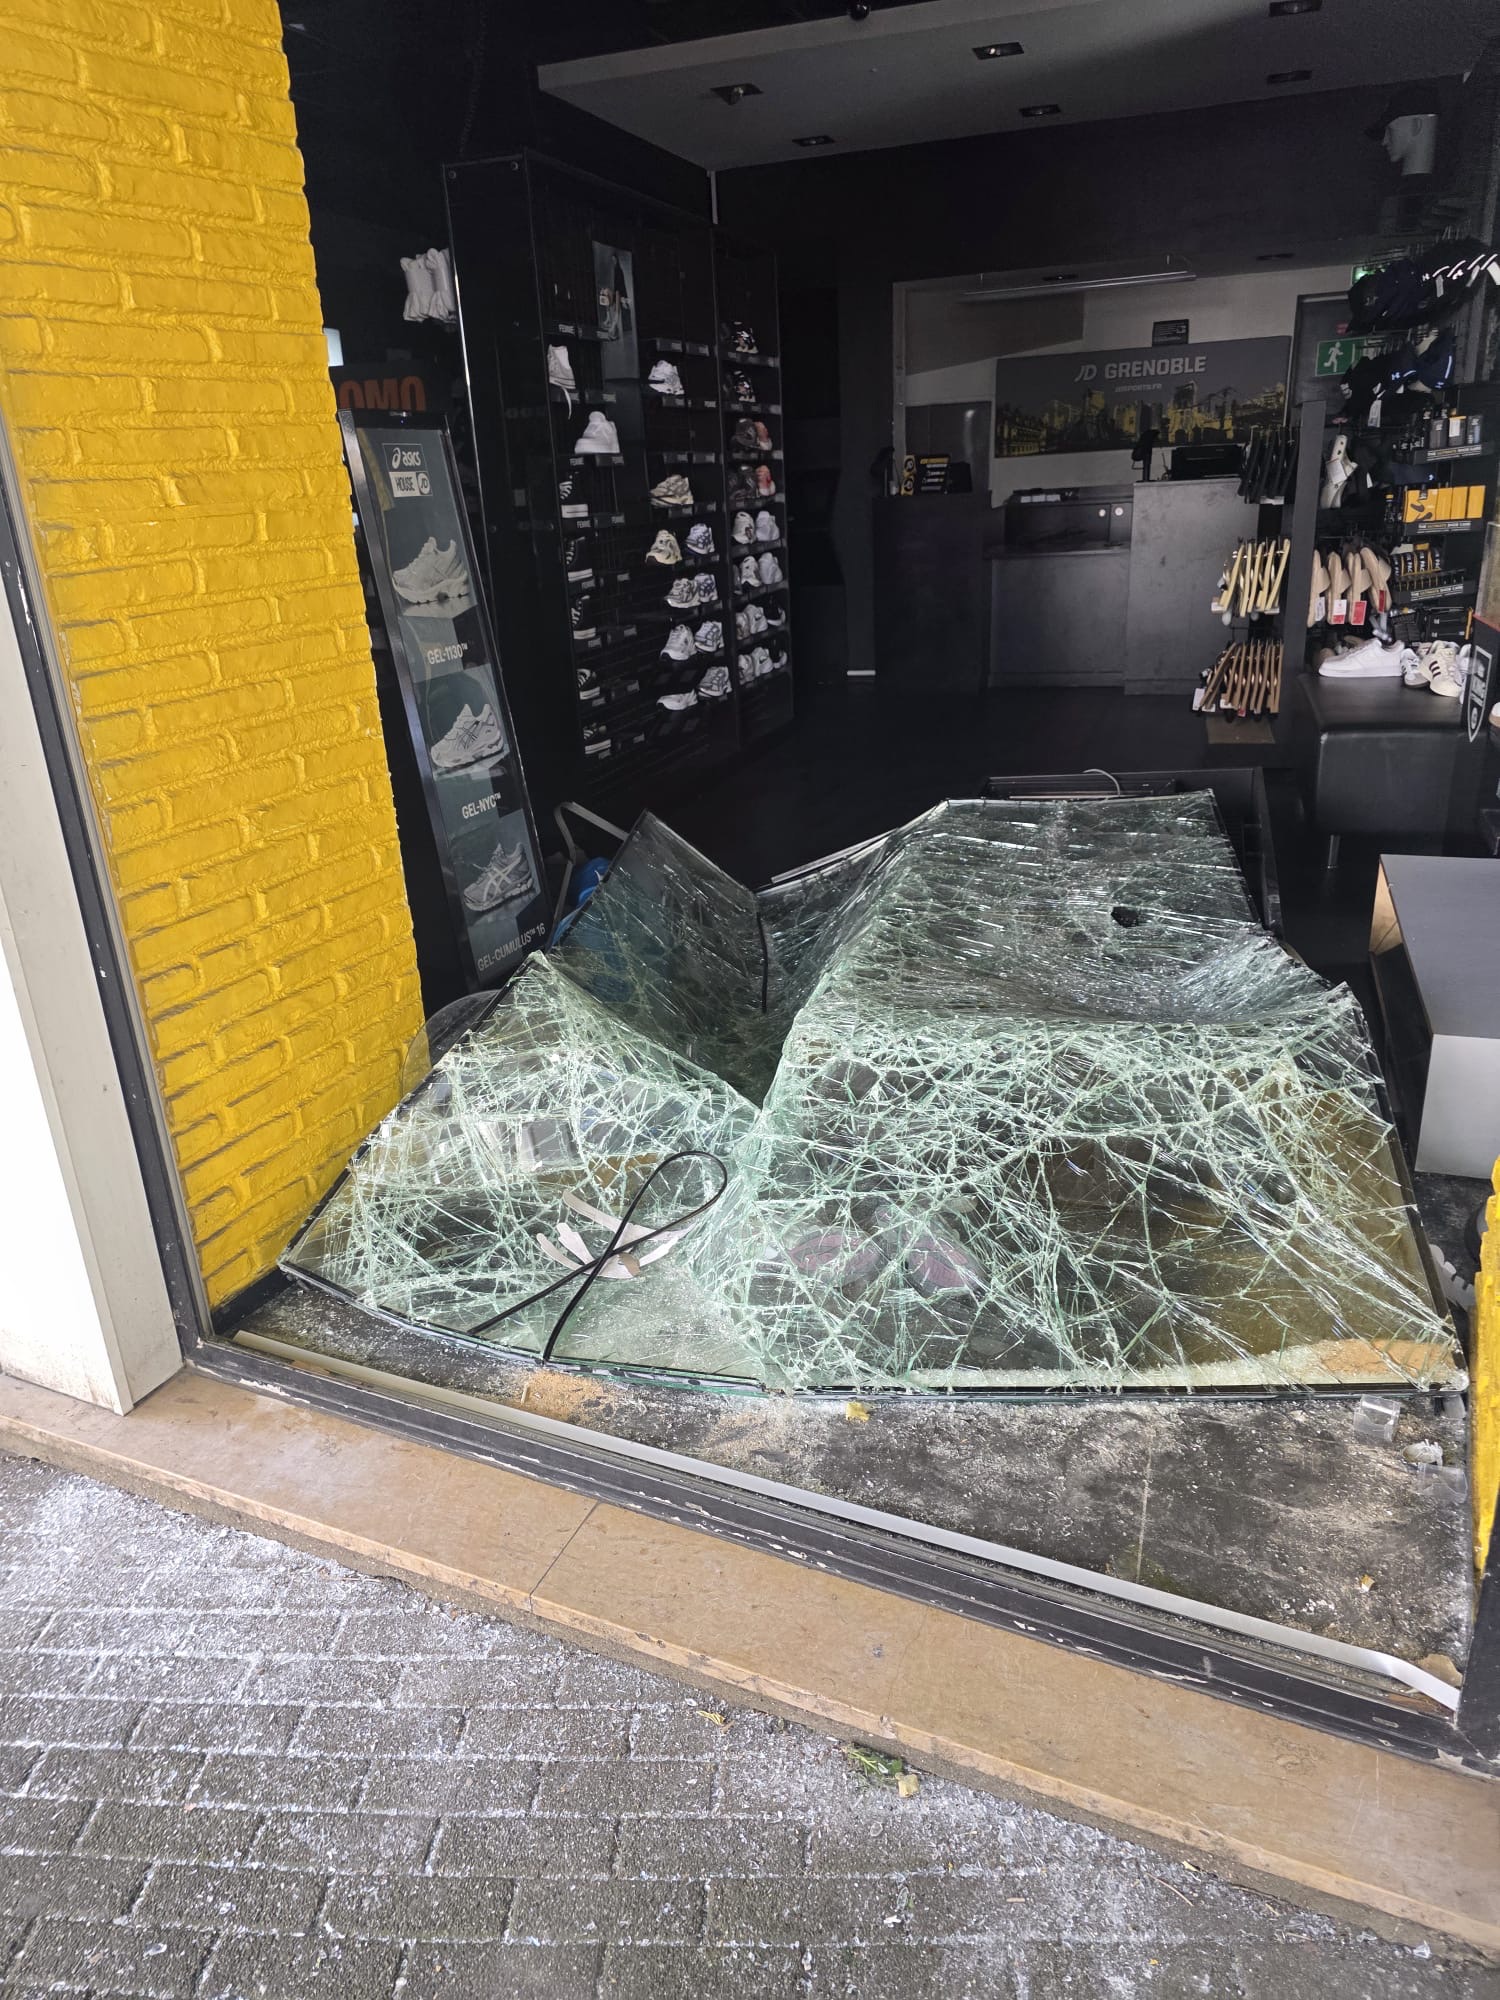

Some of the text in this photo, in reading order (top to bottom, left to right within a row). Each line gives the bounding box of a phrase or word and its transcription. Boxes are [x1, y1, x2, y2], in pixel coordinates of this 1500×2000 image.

[1074, 356, 1207, 382] JD GRENOBLE
[396, 475, 416, 492] HOUSE
[536, 922, 546, 937] 16
